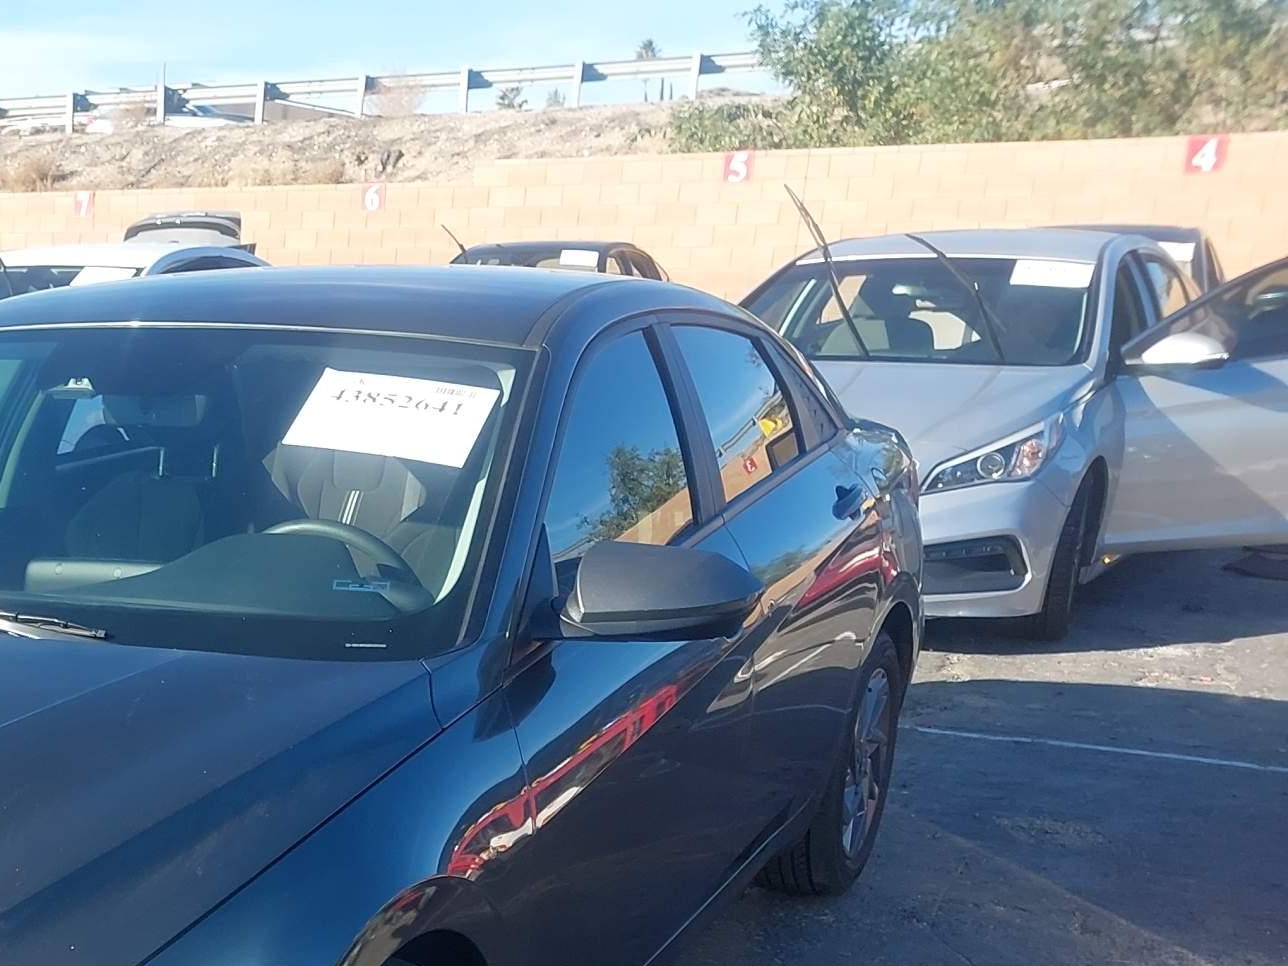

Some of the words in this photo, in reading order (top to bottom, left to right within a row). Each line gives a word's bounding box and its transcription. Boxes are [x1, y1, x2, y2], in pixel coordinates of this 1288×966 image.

[727, 151, 748, 182] 5
[1191, 138, 1217, 171] 4
[76, 191, 90, 216] 7
[364, 184, 380, 210] 6
[330, 388, 463, 416] 43852641
